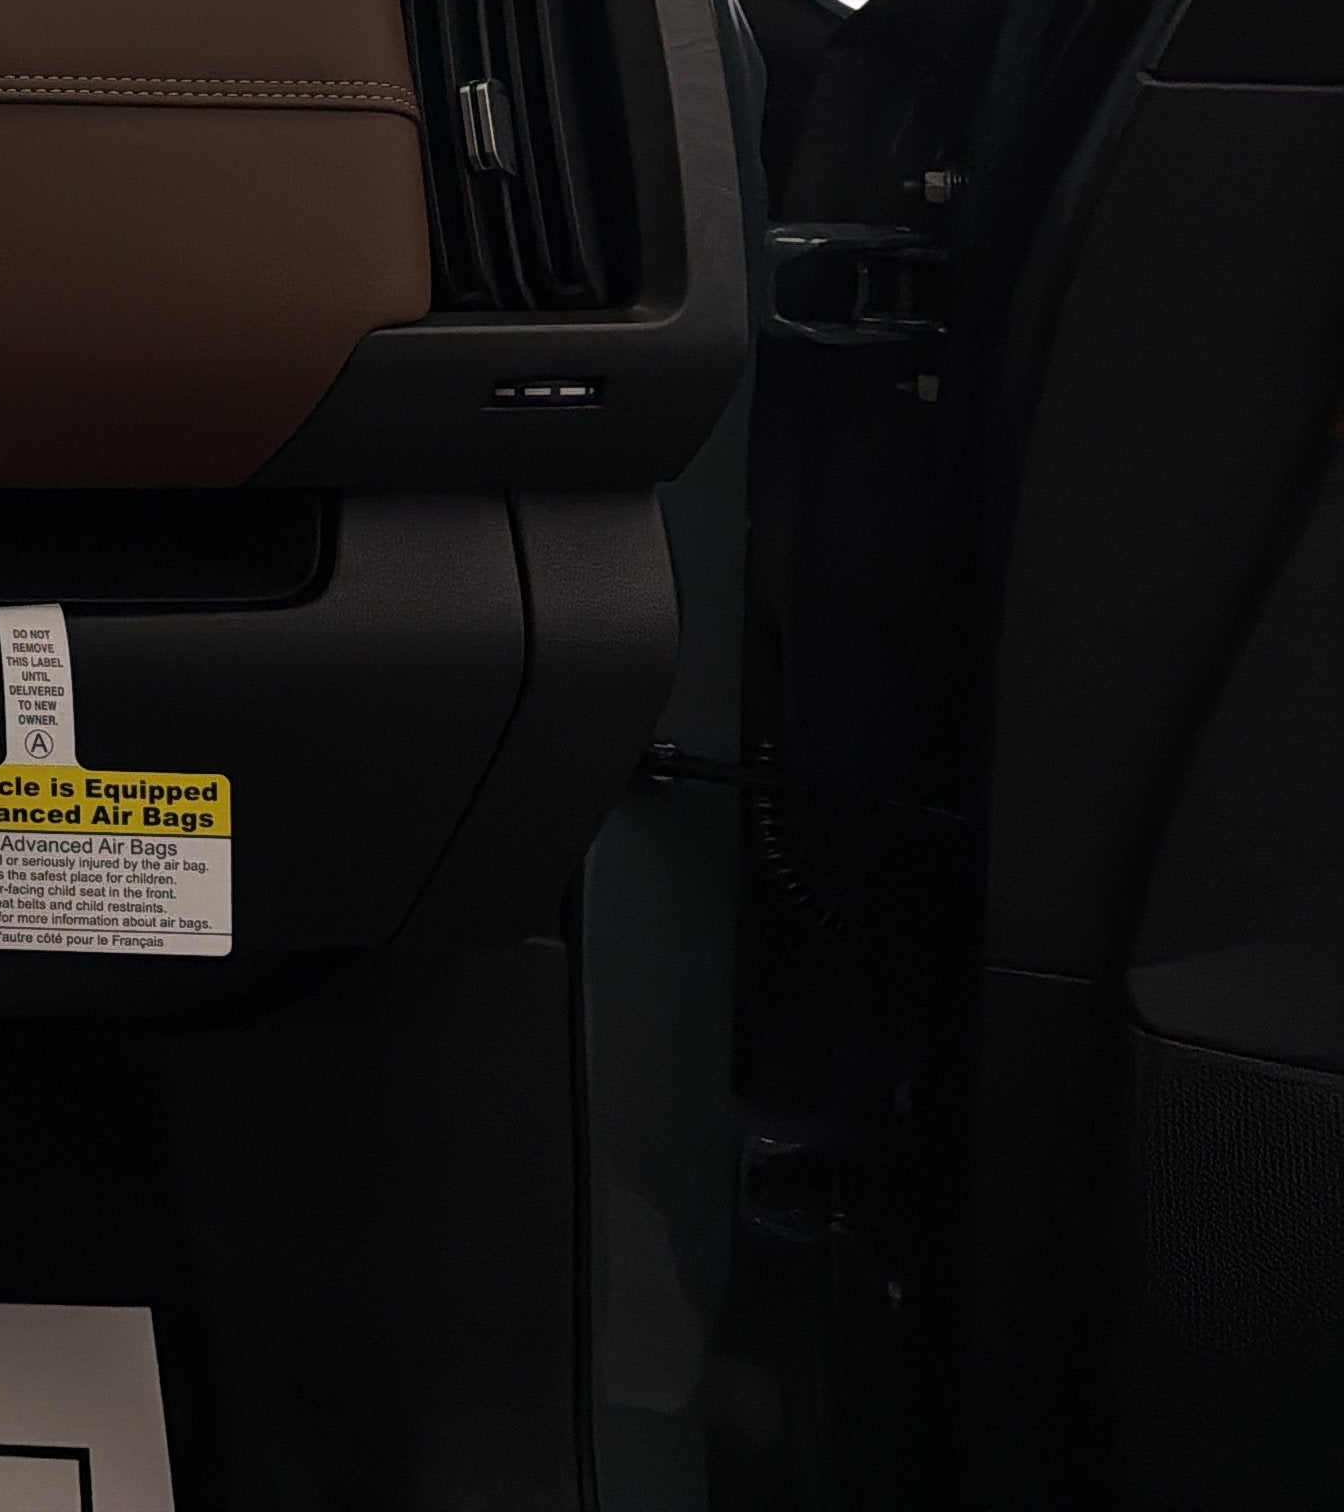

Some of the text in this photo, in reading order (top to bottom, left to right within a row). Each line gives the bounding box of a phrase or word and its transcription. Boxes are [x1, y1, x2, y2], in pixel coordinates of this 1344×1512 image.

[12, 629, 50, 639] DO NOT
[12, 643, 55, 653] REMOVE
[6, 656, 64, 668] THIS LABEL
[21, 671, 51, 682] UNTIL
[9, 685, 65, 697] DELIVERED
[18, 700, 57, 711] TO NEW
[18, 715, 59, 726] OWNER.
[31, 732, 48, 753] A
[51, 778, 75, 797] is
[85, 778, 218, 805] Equipped
[91, 805, 133, 825] Air
[143, 807, 214, 832] Bags
[0, 835, 93, 854] Advanced
[98, 838, 124, 854] Air
[130, 839, 178, 859] Bags
[6, 857, 19, 866] or
[22, 856, 75, 870] seriously
[79, 857, 119, 870] injured
[123, 858, 138, 872] by
[141, 859, 160, 870] the
[164, 860, 180, 871] air
[183, 860, 209, 874] bag.
[7, 869, 26, 880] the
[30, 870, 67, 882] safest
[70, 872, 103, 884] place
[106, 872, 122, 883] for
[125, 872, 177, 885] children.
[48, 885, 76, 896] child
[80, 887, 105, 897] seat
[109, 886, 119, 897] in
[123, 887, 143, 898] the
[146, 888, 177, 899] front.
[17, 898, 46, 910] belts
[49, 900, 73, 911] and
[76, 900, 104, 912] child
[107, 902, 167, 914] restraints.
[17, 914, 48, 924] more
[52, 914, 119, 927] information
[122, 916, 157, 927] about
[160, 917, 176, 928] air
[179, 917, 213, 932] bags.
[36, 932, 62, 944] côté
[66, 935, 95, 947] pour
[98, 935, 108, 946] le
[111, 935, 164, 949] Français
